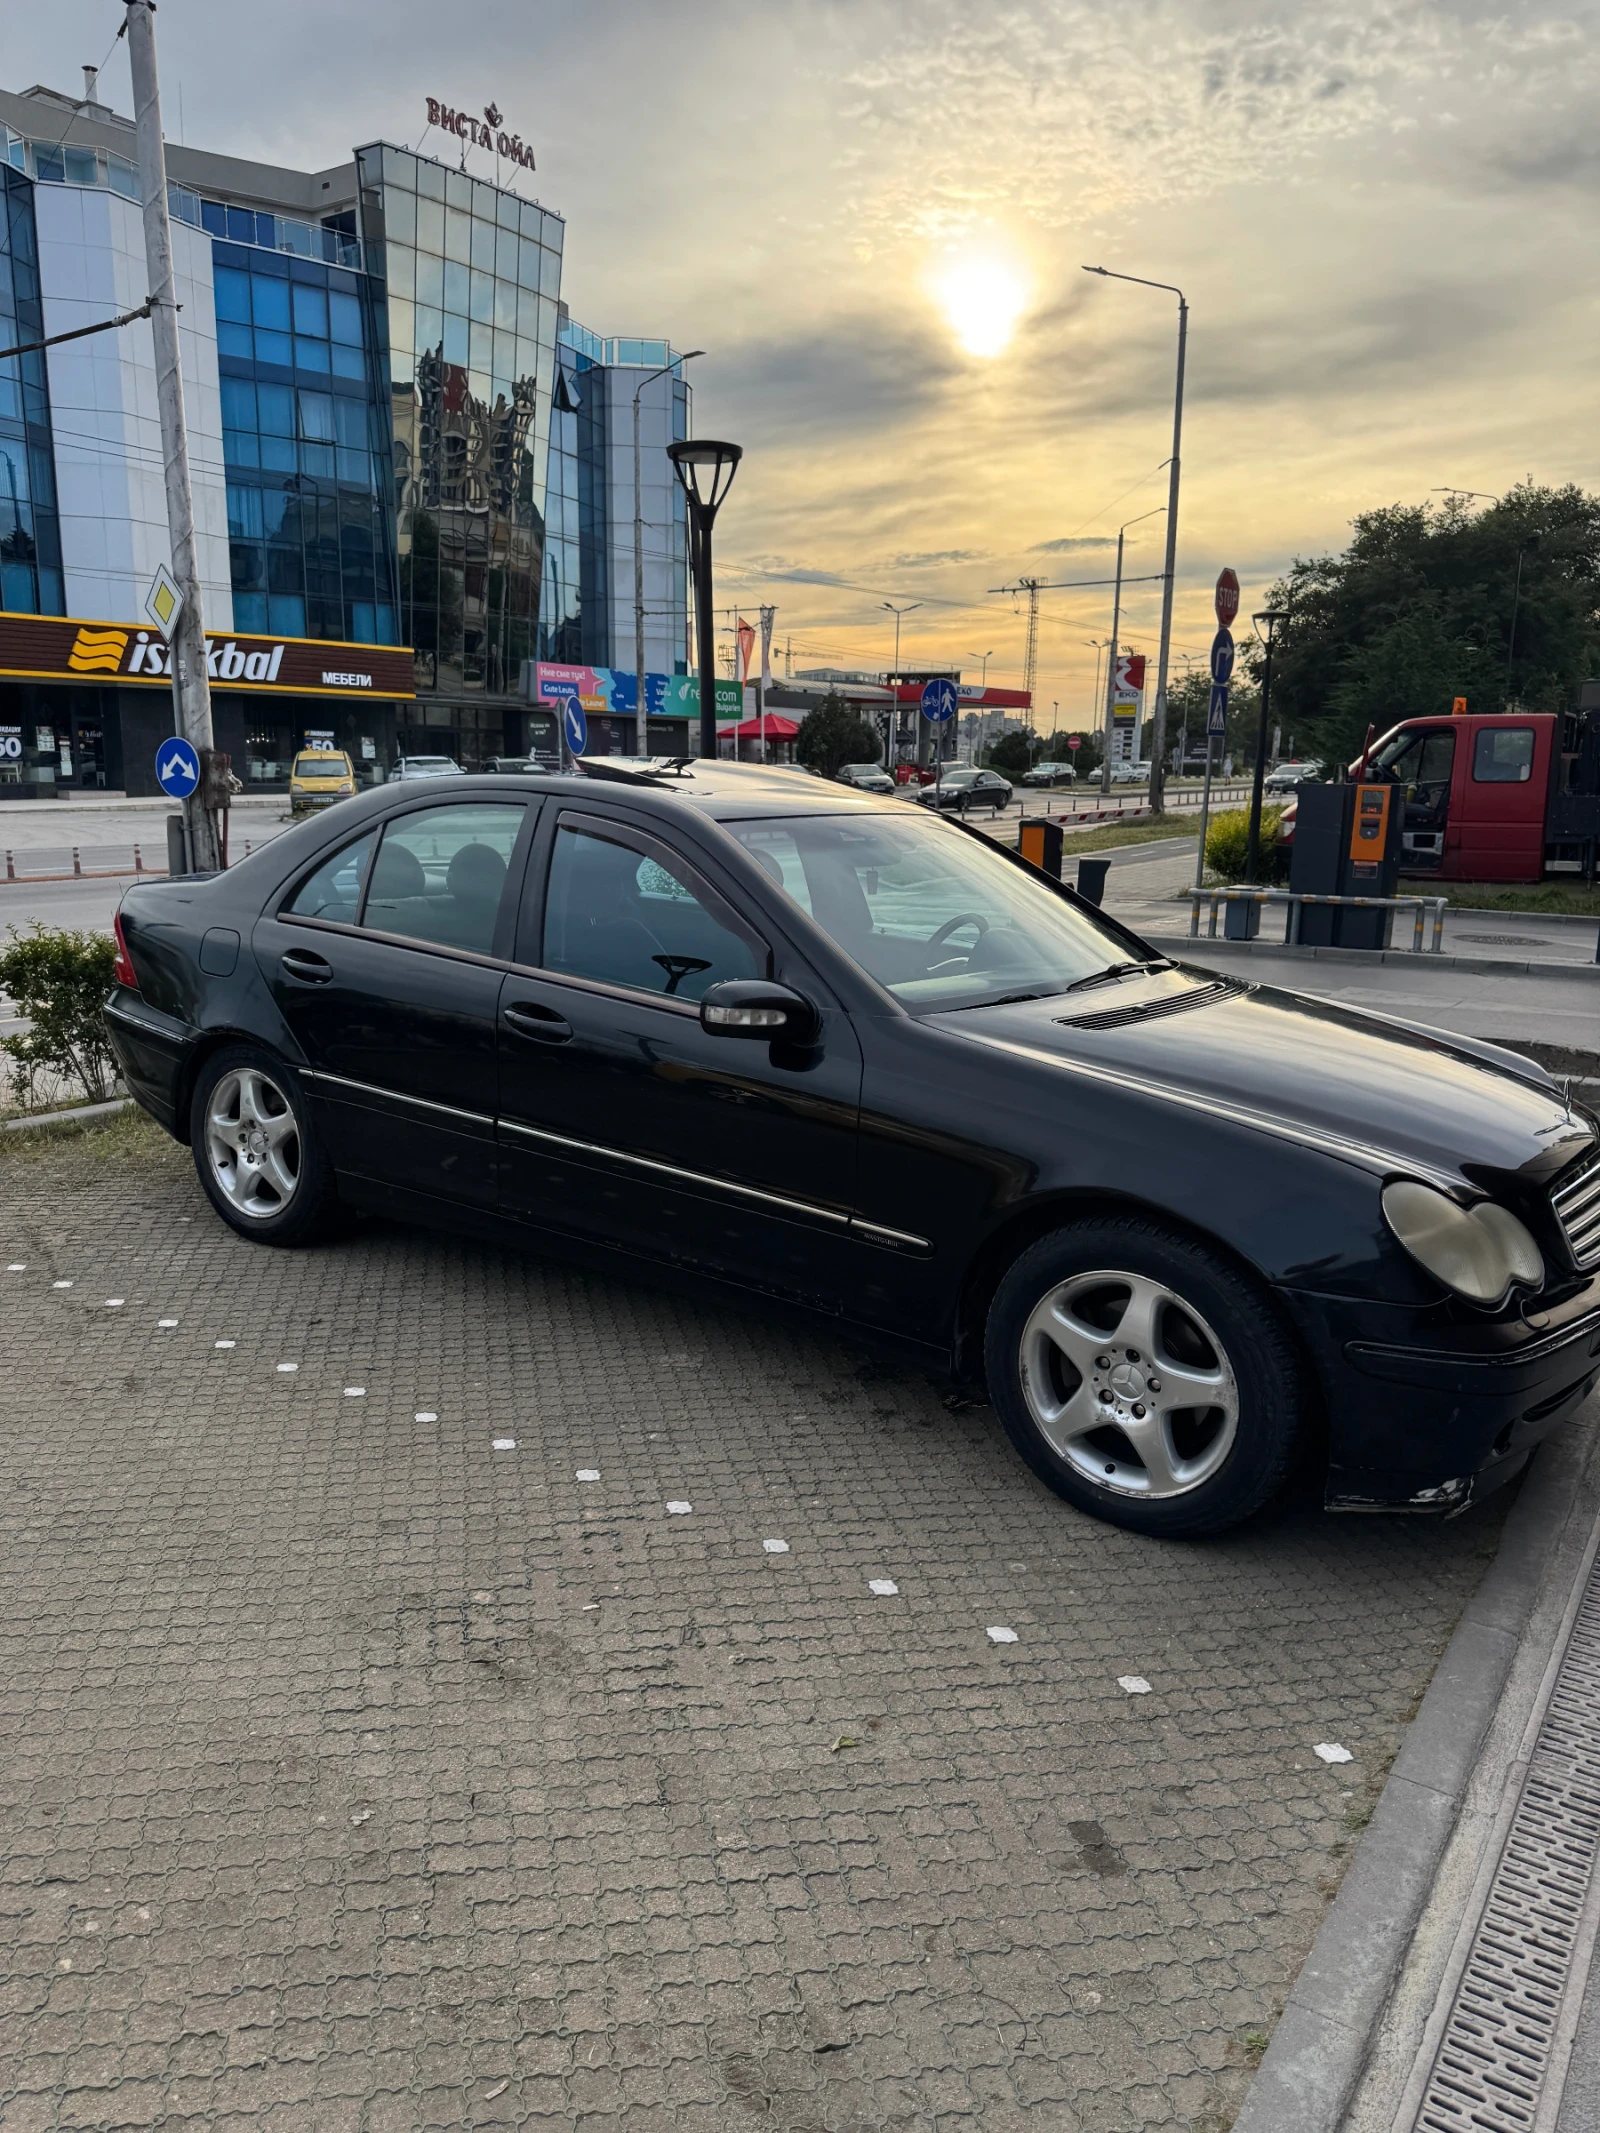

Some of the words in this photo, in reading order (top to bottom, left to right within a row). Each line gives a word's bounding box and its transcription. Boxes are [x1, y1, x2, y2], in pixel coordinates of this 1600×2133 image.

[425, 97, 493, 151] ВИСТА
[497, 131, 536, 171] ОЙЛ
[1219, 586, 1237, 608] STOP
[128, 632, 285, 681] iskbal
[322, 671, 372, 687] МЕБЕЛИ
[540, 667, 555, 677] Ние
[571, 671, 585, 681] тук!
[543, 684, 558, 693] Gute
[559, 685, 576, 695] Leute,
[690, 688, 737, 702] recom
[957, 686, 972, 696] EKO
[586, 698, 605, 707] Laune!
[716, 703, 741, 713] Bulgarien
[312, 740, 334, 751] 50
